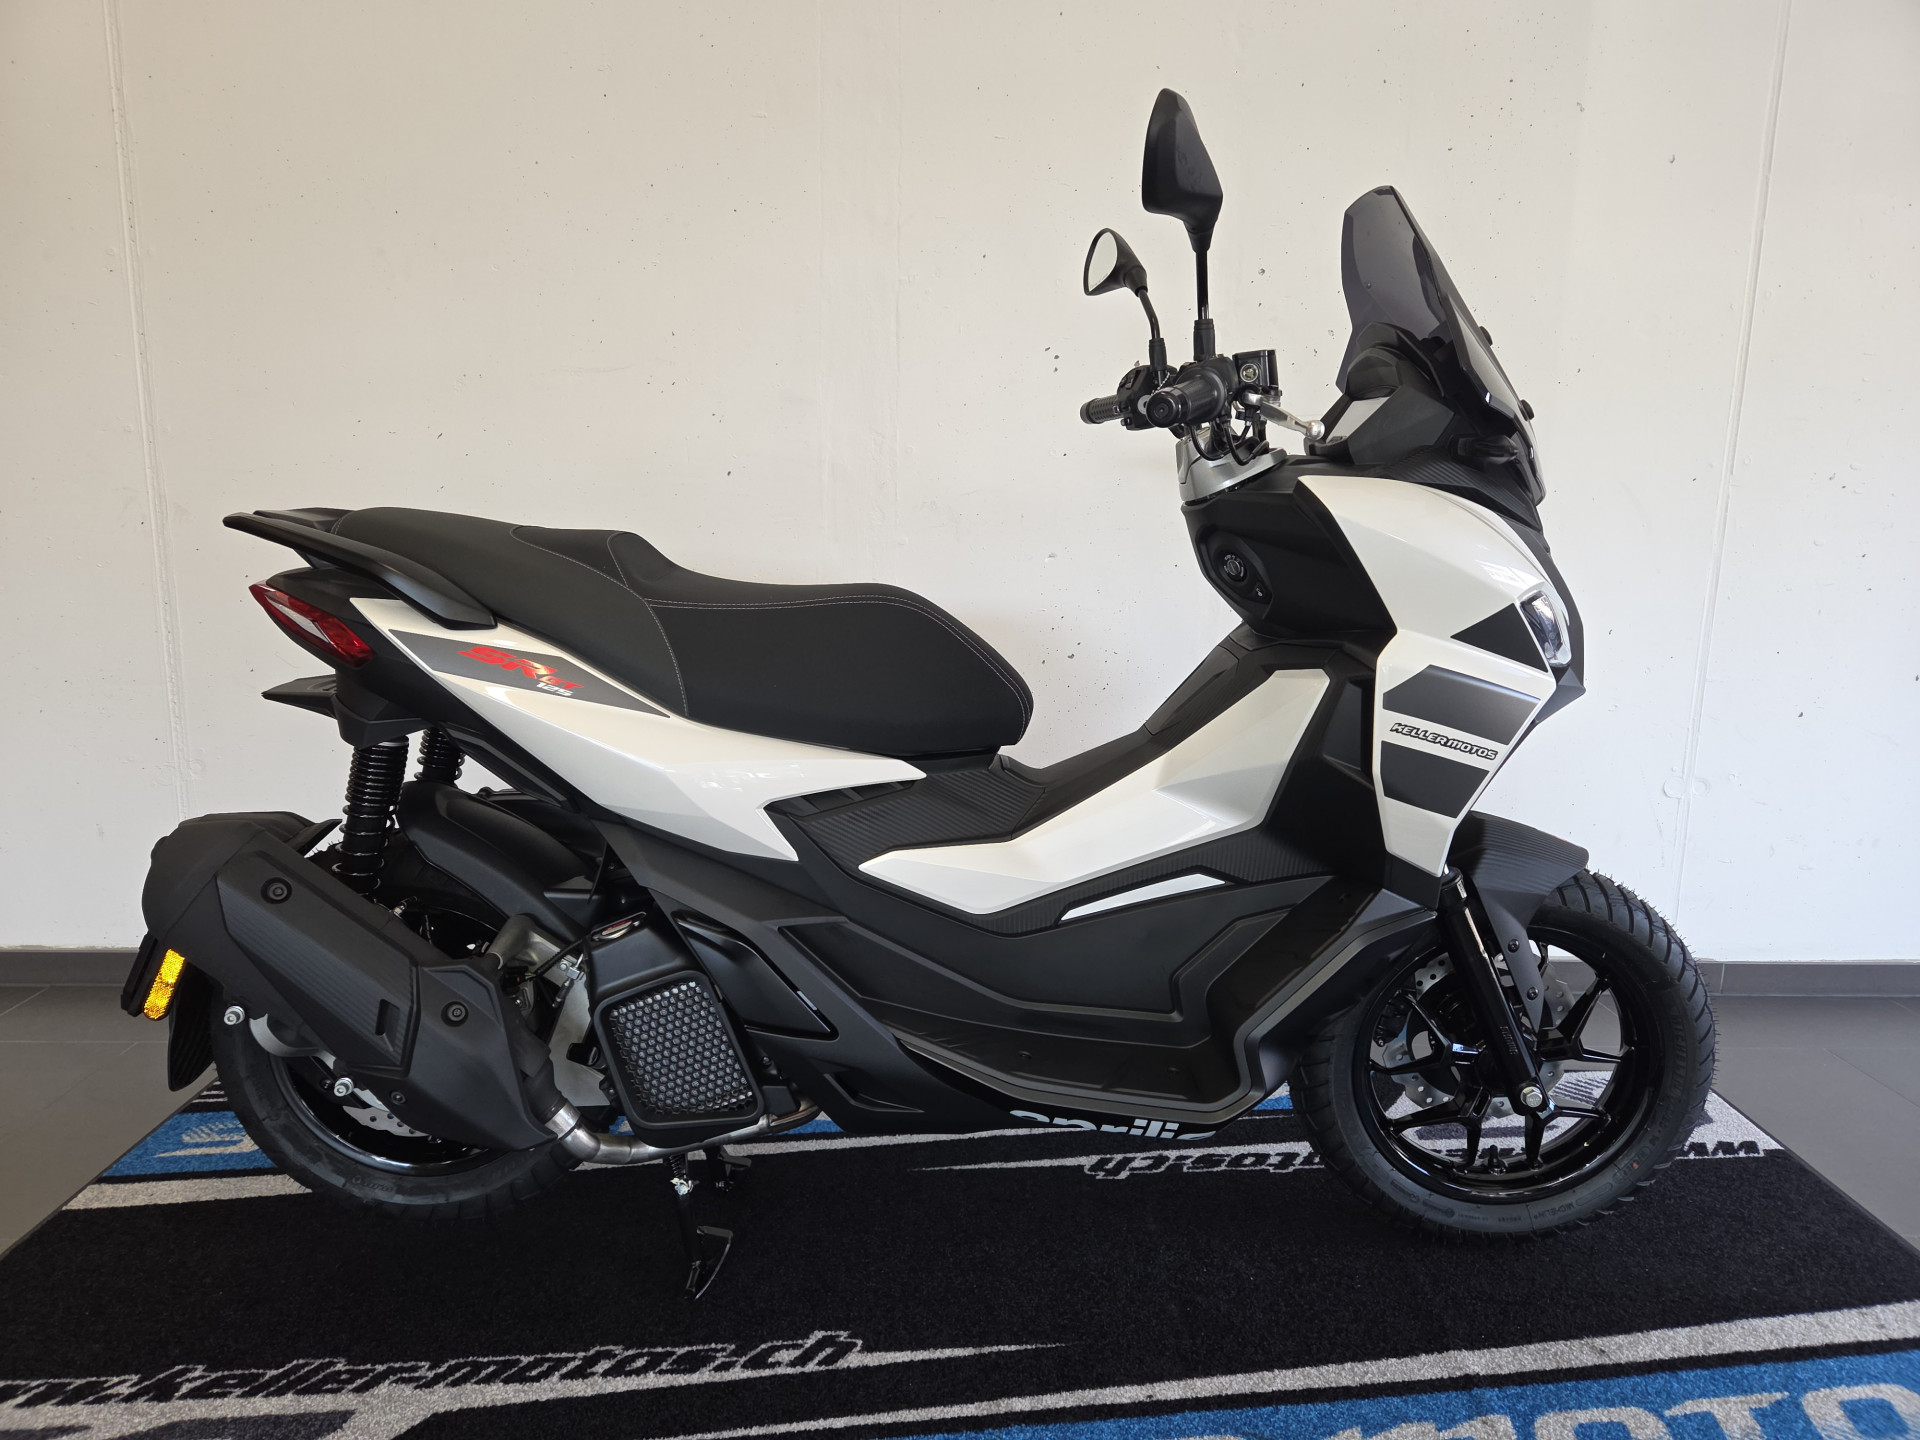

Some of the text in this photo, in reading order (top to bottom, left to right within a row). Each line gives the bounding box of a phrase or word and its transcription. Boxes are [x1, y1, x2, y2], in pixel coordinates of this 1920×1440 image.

[457, 646, 583, 690] SR GT
[536, 682, 574, 696] 125
